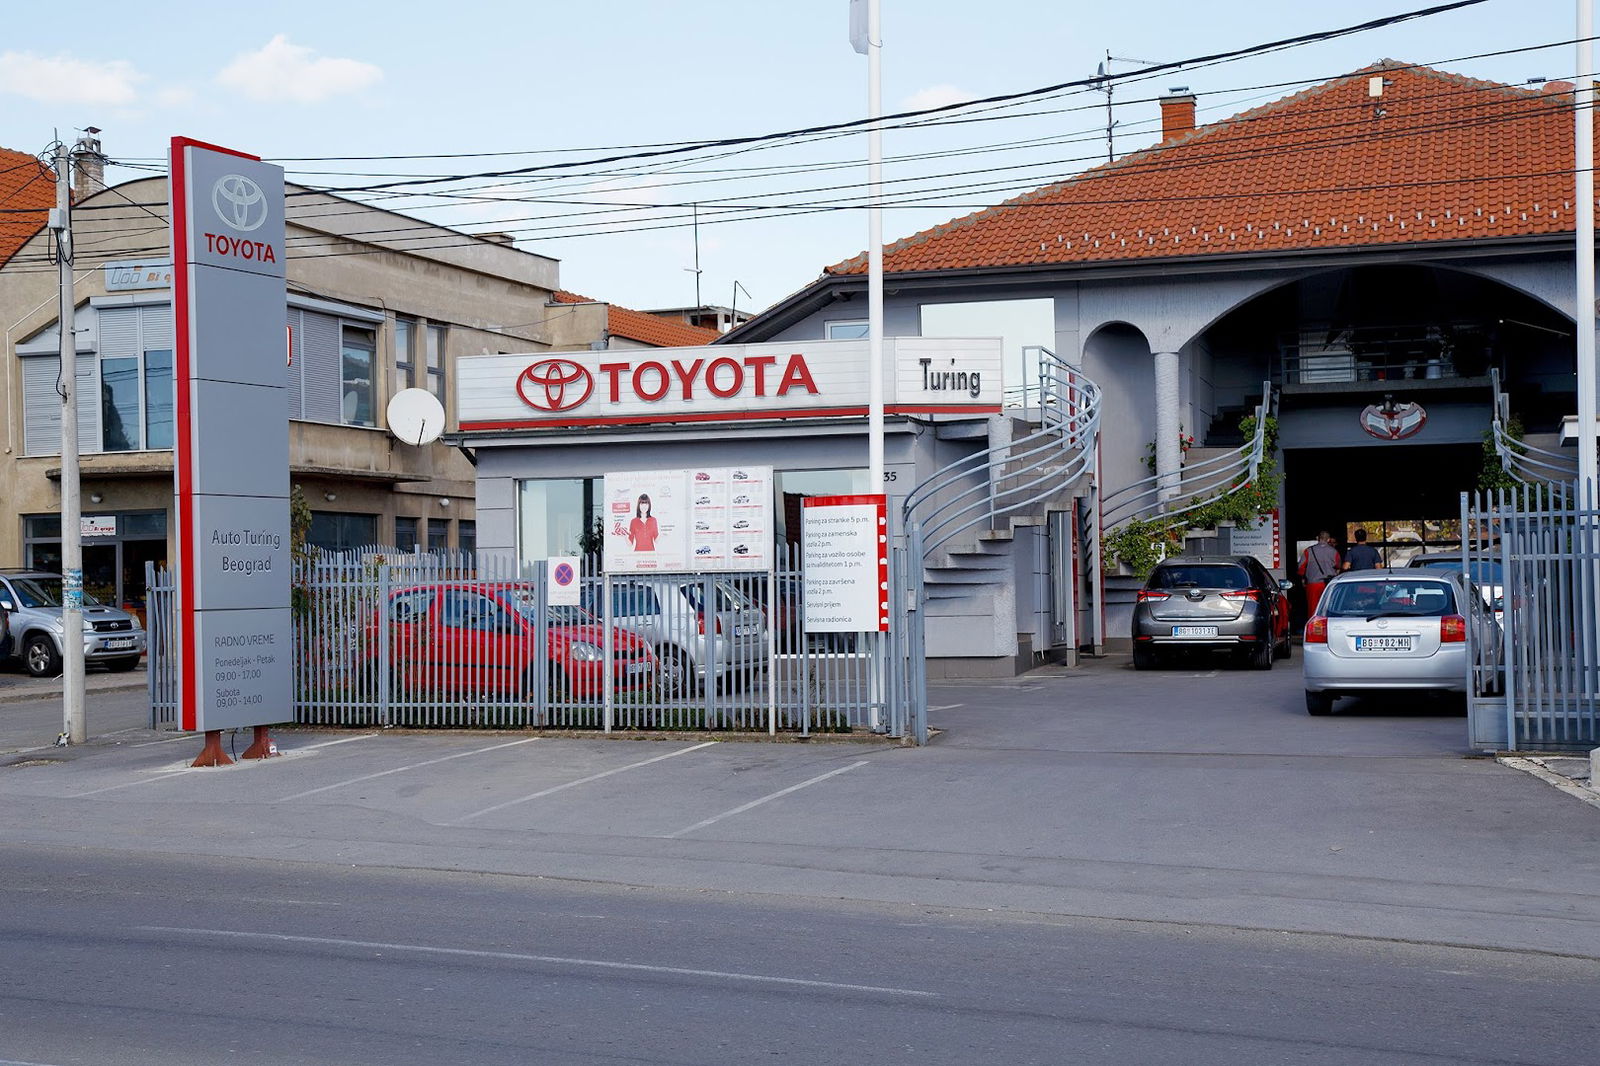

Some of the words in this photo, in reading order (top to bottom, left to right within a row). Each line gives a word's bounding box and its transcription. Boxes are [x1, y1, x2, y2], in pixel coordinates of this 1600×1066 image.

[204, 232, 276, 264] TOYOTA
[599, 353, 821, 404] TOYOTA
[918, 357, 981, 398] Turing
[211, 529, 241, 545] Auto
[243, 528, 280, 550] Turing
[222, 555, 272, 576] Beograd
[214, 635, 246, 648] RADNO
[246, 633, 275, 646] VREME
[215, 655, 252, 668] Ponedeljak
[257, 654, 276, 665] Petak
[216, 688, 241, 699] Subota
